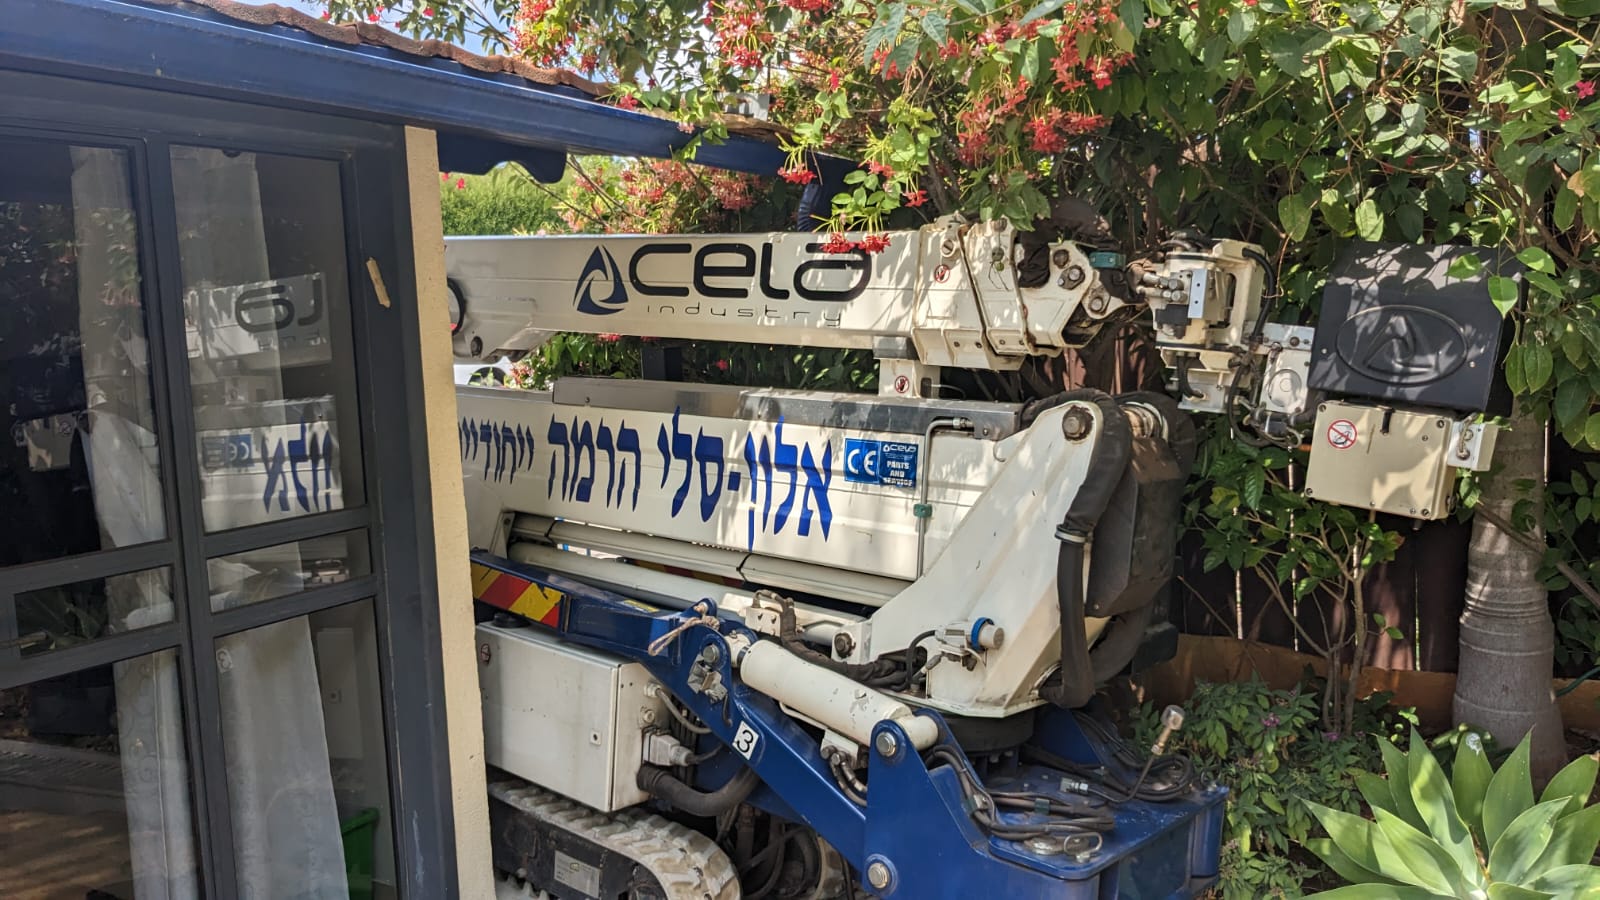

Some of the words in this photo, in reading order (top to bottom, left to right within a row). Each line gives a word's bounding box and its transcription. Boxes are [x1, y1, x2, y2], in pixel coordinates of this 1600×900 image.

[647, 301, 841, 327] industry
[458, 415, 535, 485] ייחודיי
[547, 412, 642, 512] הרמה
[847, 448, 877, 477] CE
[886, 460, 910, 470] PARTS
[890, 470, 905, 478] AND
[657, 405, 833, 553] אלון-סלי
[736, 729, 754, 753] 3
